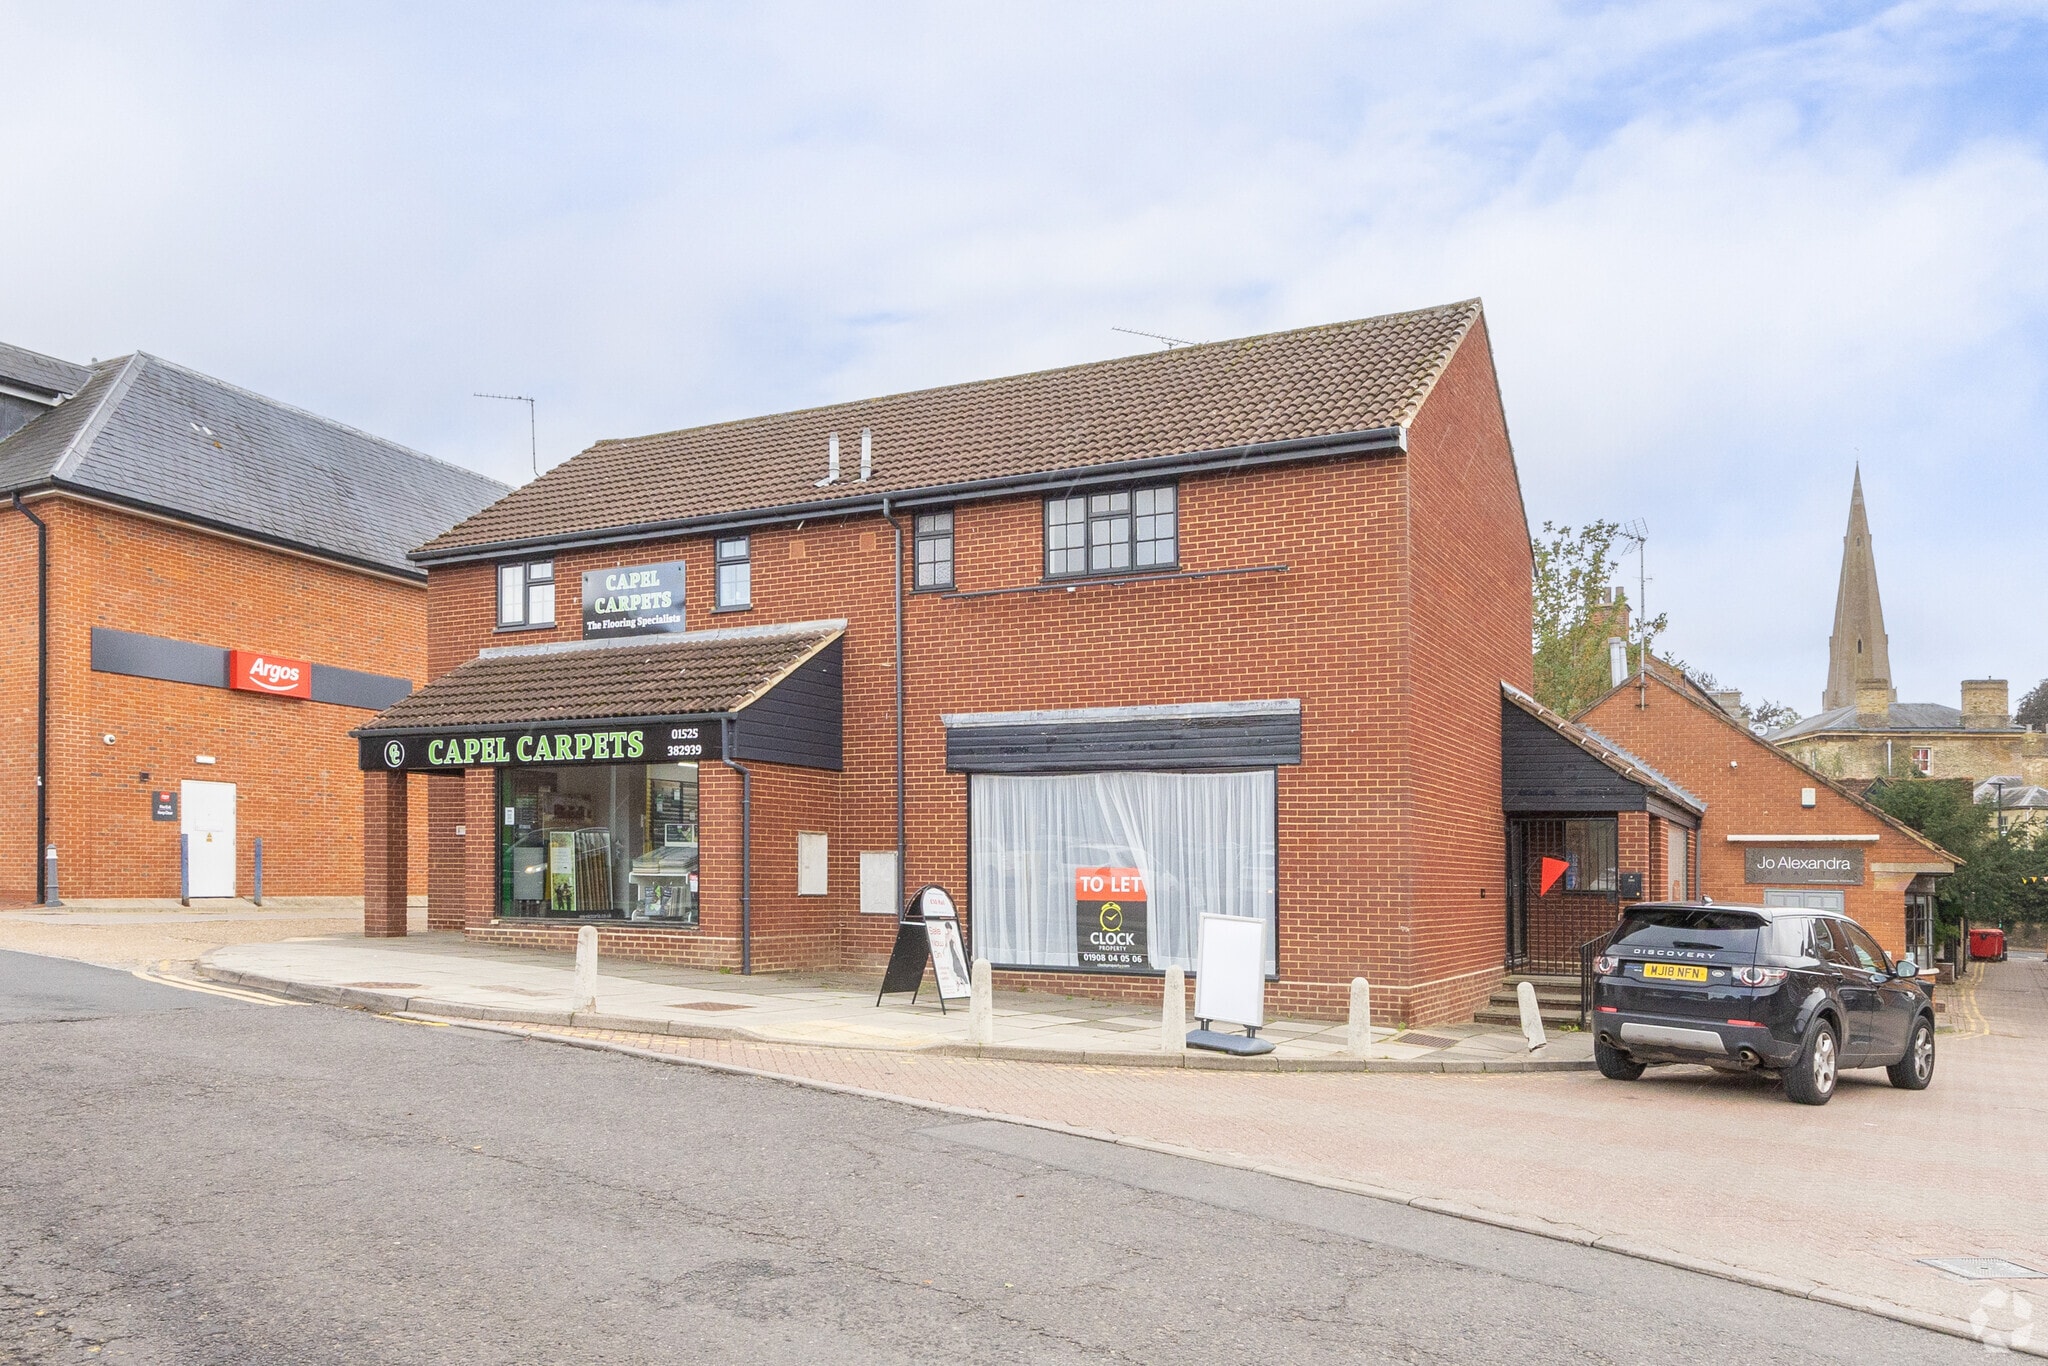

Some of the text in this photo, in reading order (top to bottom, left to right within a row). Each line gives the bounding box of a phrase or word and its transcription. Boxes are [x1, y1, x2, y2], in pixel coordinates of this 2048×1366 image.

[606, 570, 660, 591] CAPEL
[594, 591, 672, 614] CARPETS
[587, 614, 681, 630] The Flooring Specialists
[249, 657, 300, 683] Argos
[671, 728, 699, 740] 01525
[428, 730, 644, 765] CAPEL CARPETS
[667, 744, 702, 757] 382939
[1757, 856, 1851, 870] Jo Alexandra
[1080, 876, 1143, 893] TO LET
[928, 926, 942, 935] Sale
[1090, 932, 1135, 945] CLOCK
[1083, 953, 1143, 963] 01908 04 05 06
[1634, 948, 1716, 959] DISCOVERY
[1677, 967, 1700, 979] NFN
